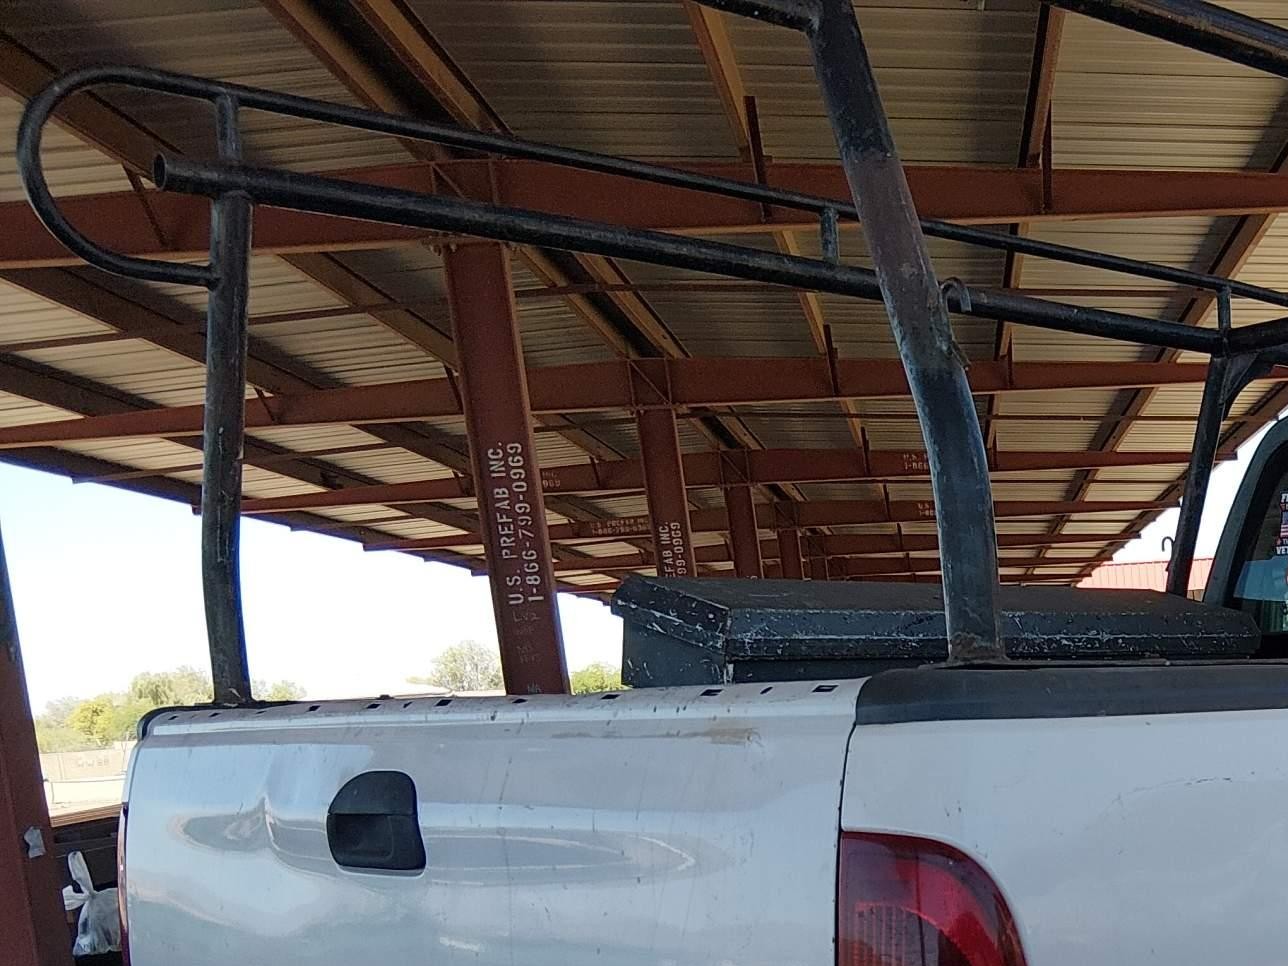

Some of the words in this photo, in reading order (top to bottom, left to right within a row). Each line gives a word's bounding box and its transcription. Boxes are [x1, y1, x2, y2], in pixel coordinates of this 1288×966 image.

[487, 442, 507, 478] INC.
[494, 487, 520, 559] PREFAB
[506, 443, 544, 602] 1-866-799-0969
[659, 521, 671, 545] INC.
[662, 550, 676, 577] EFAB
[506, 569, 525, 604] U.S.
